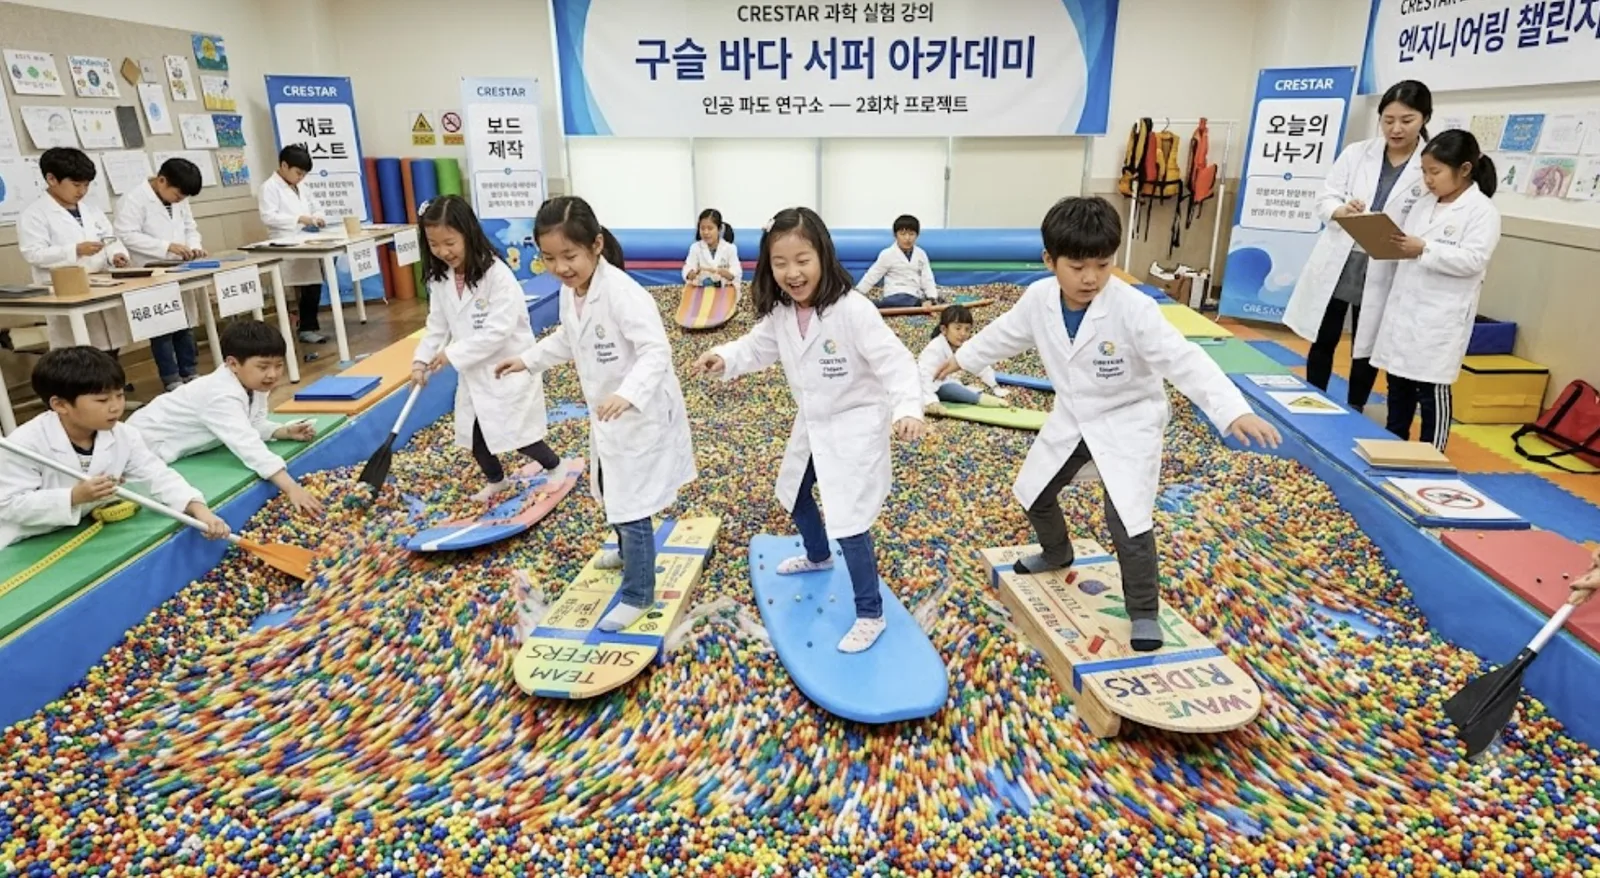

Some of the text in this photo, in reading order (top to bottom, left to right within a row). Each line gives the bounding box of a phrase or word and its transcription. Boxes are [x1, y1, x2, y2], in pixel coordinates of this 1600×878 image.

[737, 2, 934, 23] CRESTAR 과학 실험 강의
[1399, 7, 1510, 63] 엔지니어링
[635, 35, 1036, 80] 구슬 바다 서퍼 아카데미
[282, 85, 338, 97] CRESTAR
[476, 86, 526, 97] CRESTAR
[1274, 78, 1334, 91] CRESTAR
[702, 95, 735, 115] 인공
[739, 95, 771, 115] 파도
[775, 95, 824, 115] 연구소
[856, 95, 900, 115] 2회차
[903, 95, 969, 114] 프로젝트
[296, 117, 337, 138] 재료
[487, 117, 523, 134] 보드
[1266, 114, 1329, 137] 오늘의
[299, 141, 348, 160] 스트
[488, 139, 524, 160] 제작
[1262, 141, 1324, 164] 나누기
[526, 643, 640, 668] SURFERS
[530, 666, 595, 685] TEAM
[1103, 662, 1235, 699] RIDERS
[1164, 693, 1252, 720] WAVE
